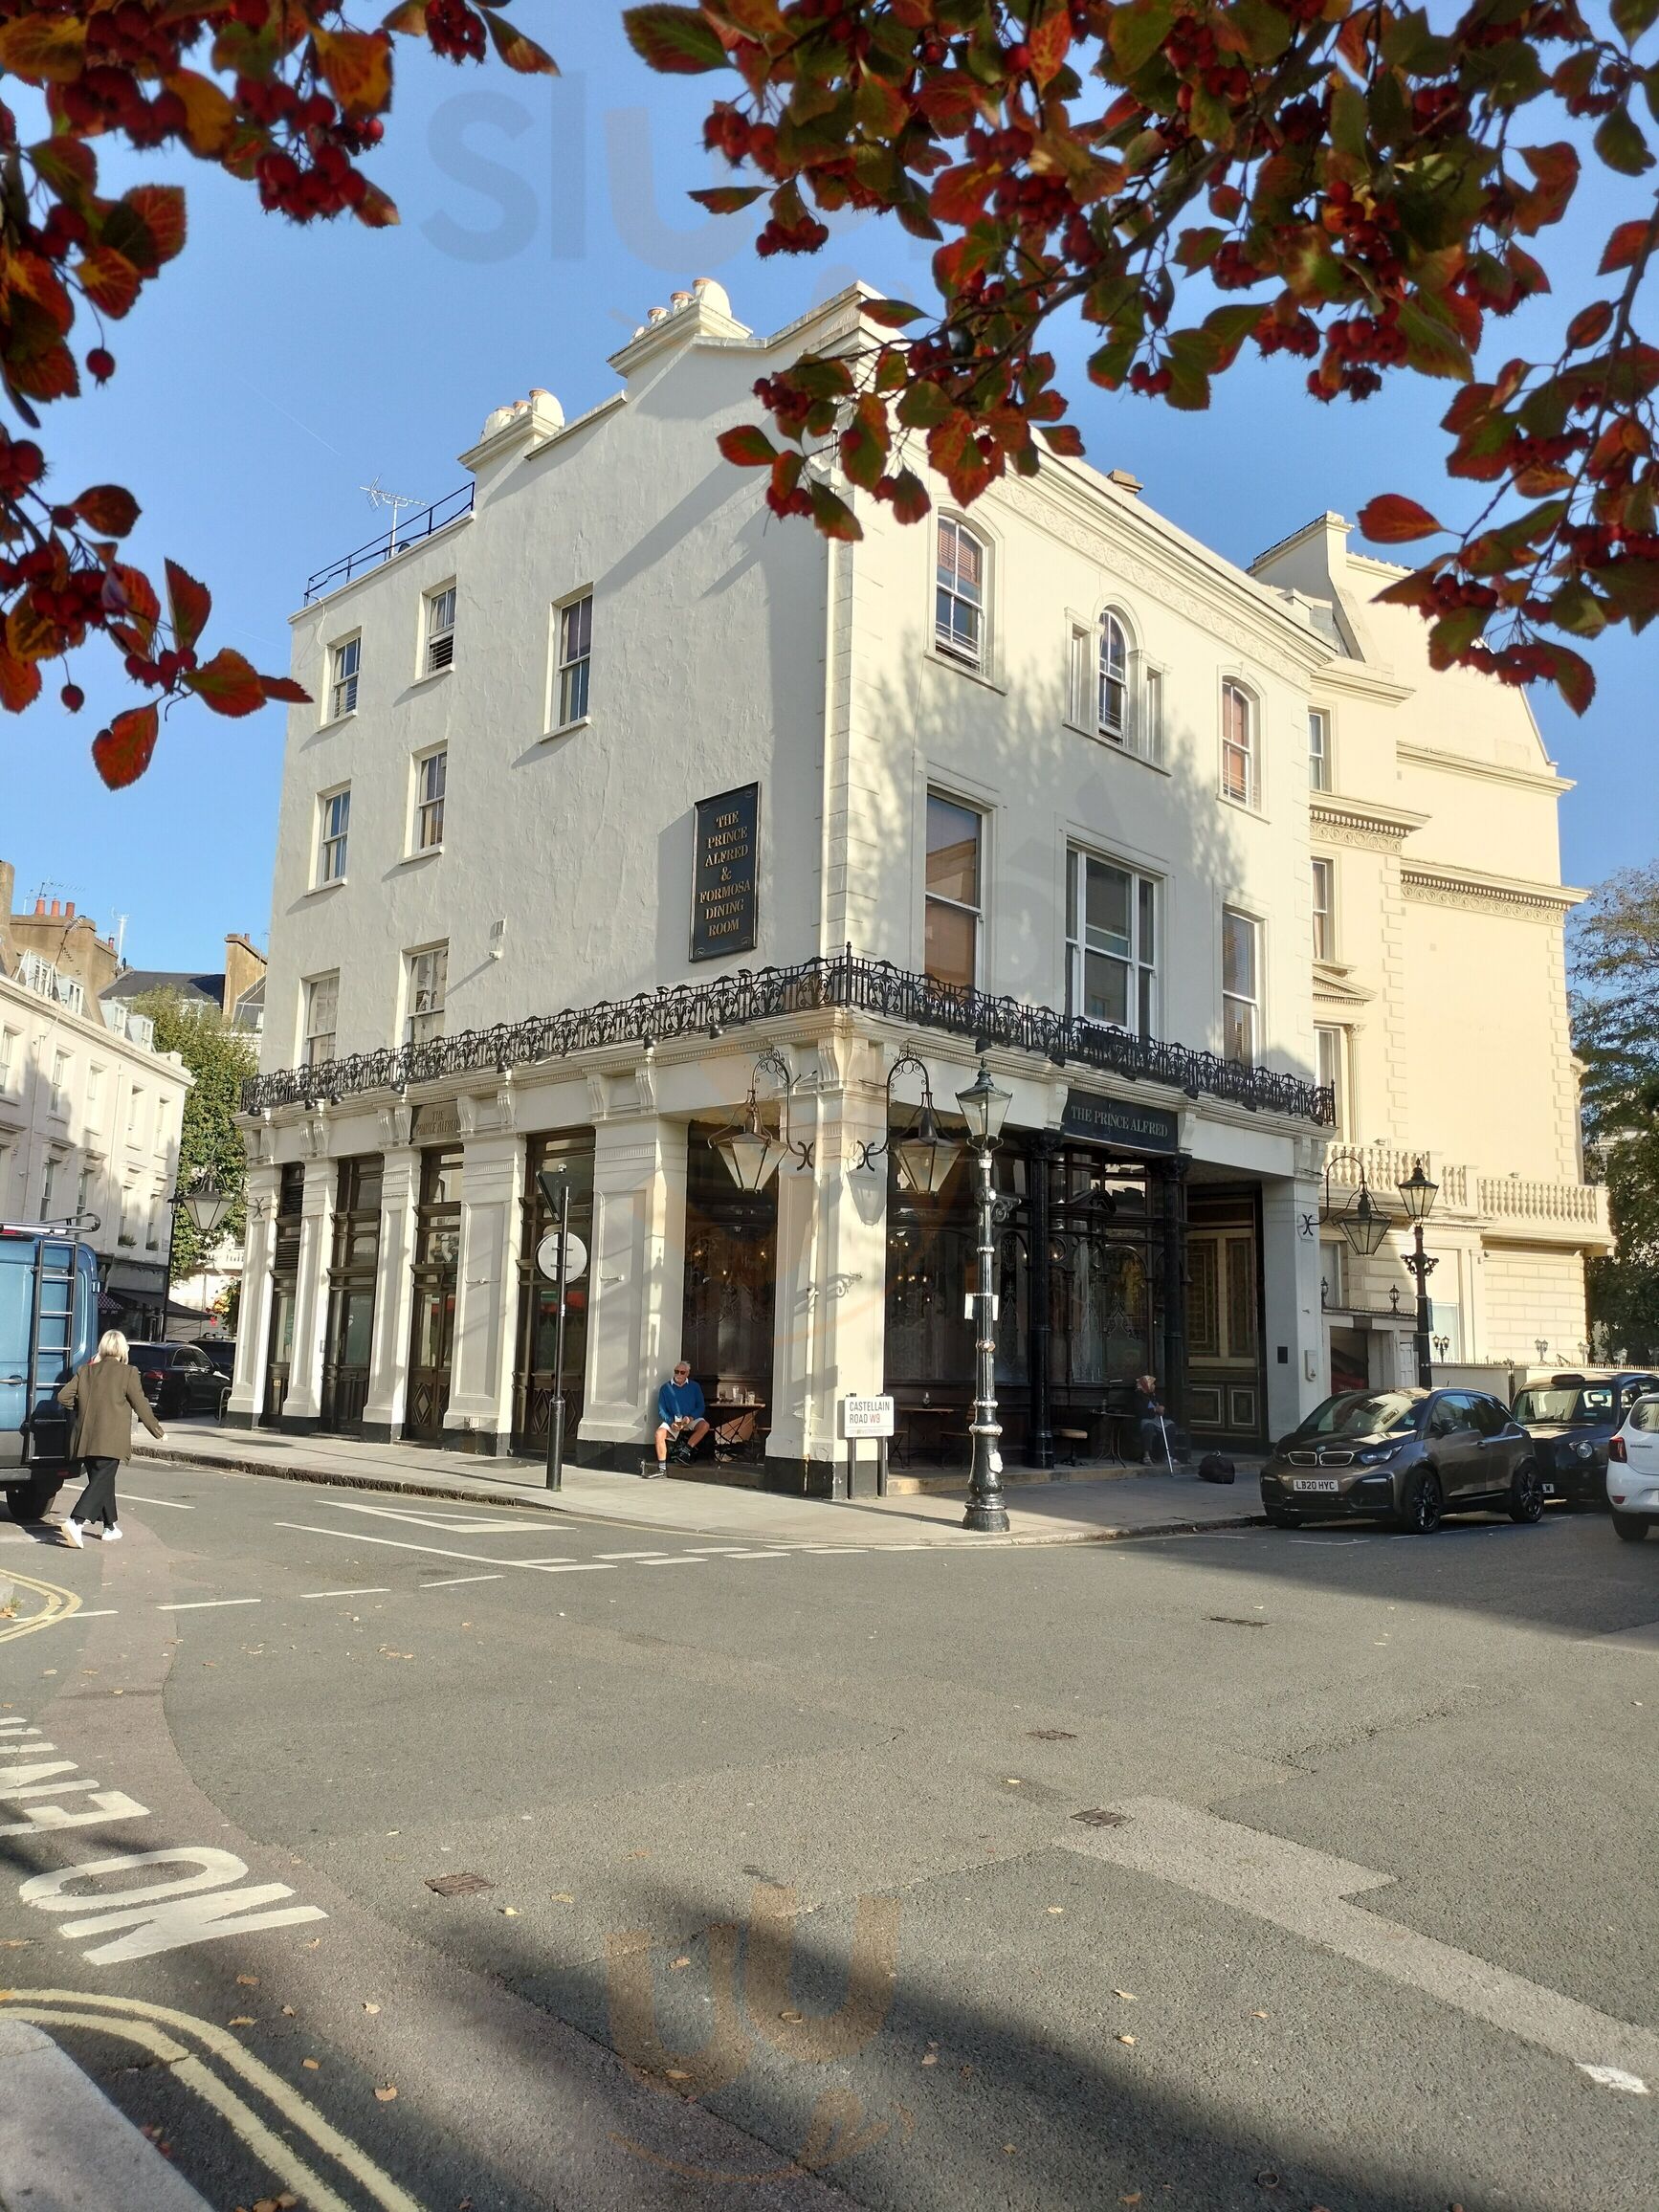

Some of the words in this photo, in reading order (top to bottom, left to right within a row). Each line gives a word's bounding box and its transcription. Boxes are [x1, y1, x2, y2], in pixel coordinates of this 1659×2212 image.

[716, 810, 740, 829] THE
[707, 827, 748, 850] PRINCE
[704, 844, 749, 868] ALFRED
[719, 866, 732, 882] &
[698, 879, 751, 904] FORMOSA
[704, 898, 744, 920] DINING
[707, 918, 741, 938] ROOM
[1071, 1105, 1093, 1122] THE
[1094, 1110, 1130, 1130] PRINCE
[1130, 1118, 1168, 1138] ALFRED
[850, 1401, 890, 1412] CASTELLAIN
[849, 1413, 869, 1425] ROAD
[869, 1413, 881, 1424] W9
[1295, 1480, 1317, 1490] LB20
[1317, 1481, 1336, 1491] HYC
